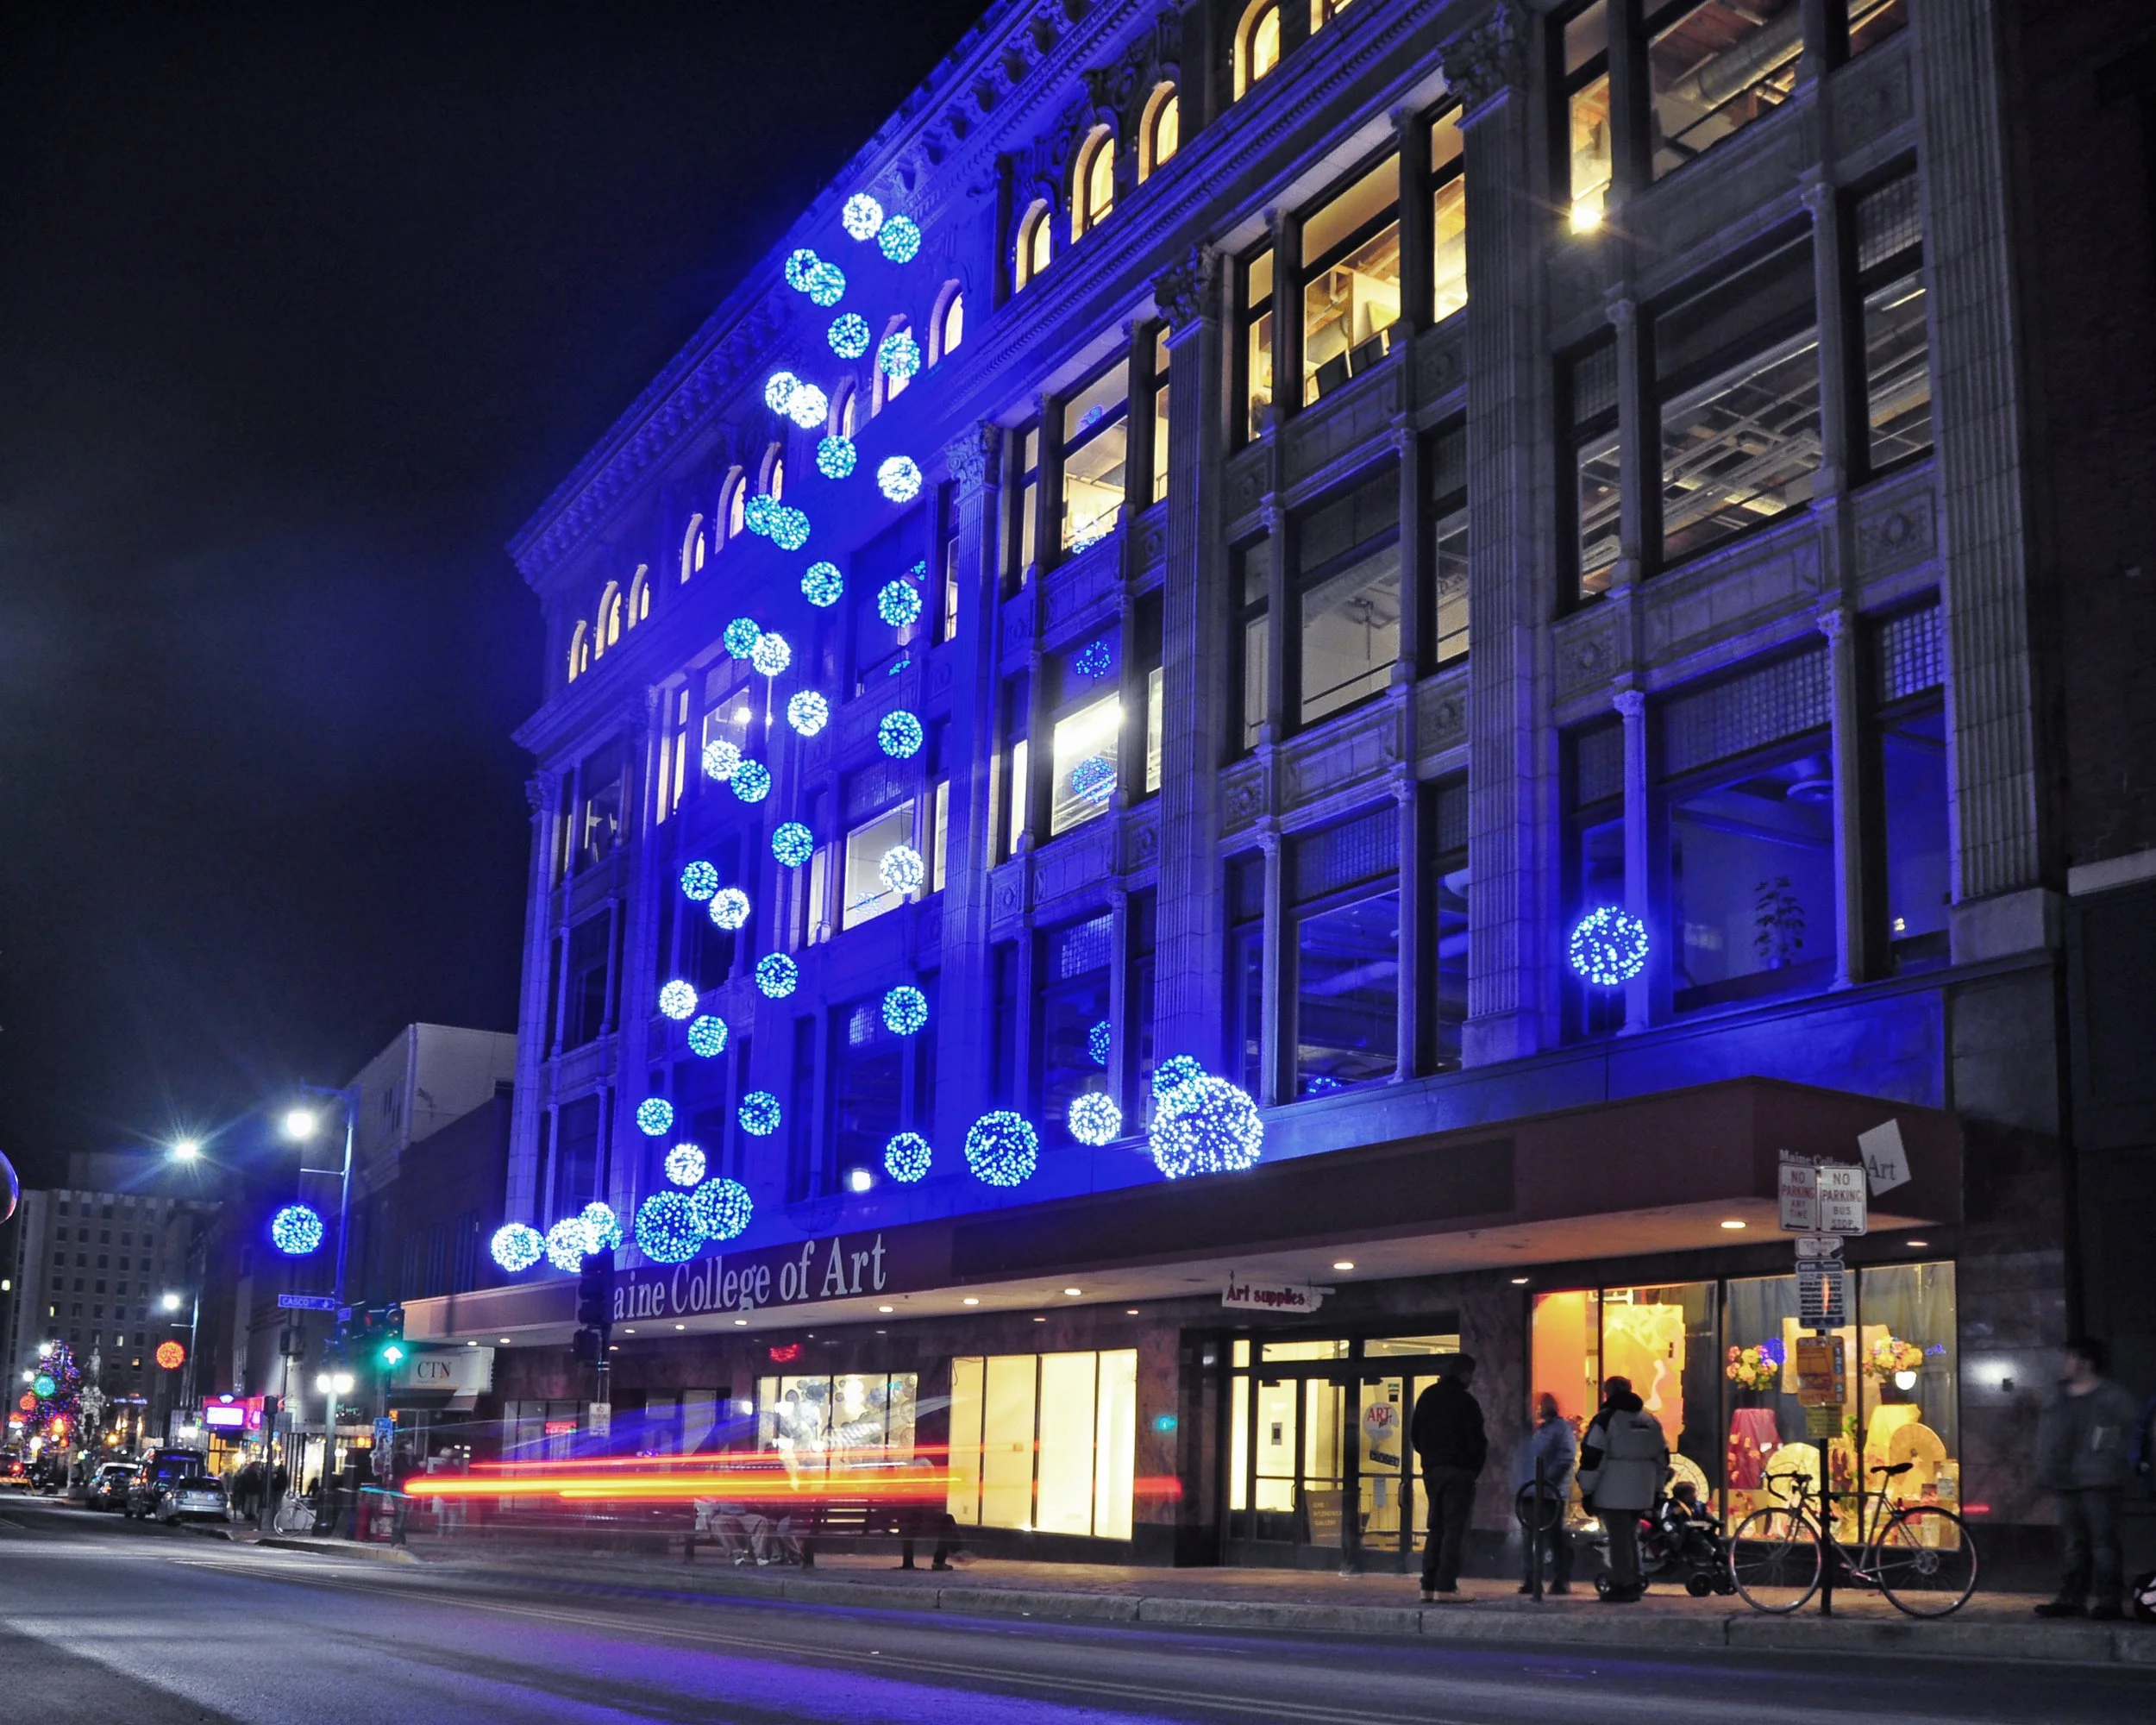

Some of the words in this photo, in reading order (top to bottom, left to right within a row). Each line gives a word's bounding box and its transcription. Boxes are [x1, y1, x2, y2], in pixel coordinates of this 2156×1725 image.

[1779, 1149, 1811, 1164] Maine
[1868, 1154, 1896, 1180] Art
[1791, 1171, 1805, 1184] NO
[1833, 1173, 1851, 1185] NO
[1783, 1185, 1815, 1199] PARKING
[1822, 1189, 1863, 1202] PARKING
[1791, 1200, 1806, 1208] ANY
[1789, 1209, 1808, 1219] TIME
[1833, 1207, 1852, 1215] BUS
[1832, 1219, 1853, 1228] STOP
[613, 1271, 665, 1320] aine
[672, 1256, 770, 1312] College
[780, 1240, 814, 1301] of
[820, 1233, 886, 1295] Art
[282, 1297, 309, 1306] CASCO
[1226, 1283, 1250, 1302] Art
[1254, 1288, 1305, 1307] supplies
[417, 1361, 451, 1378] CTN
[1367, 1407, 1391, 1422] ART
[1370, 1451, 1400, 1466] CLOSED
